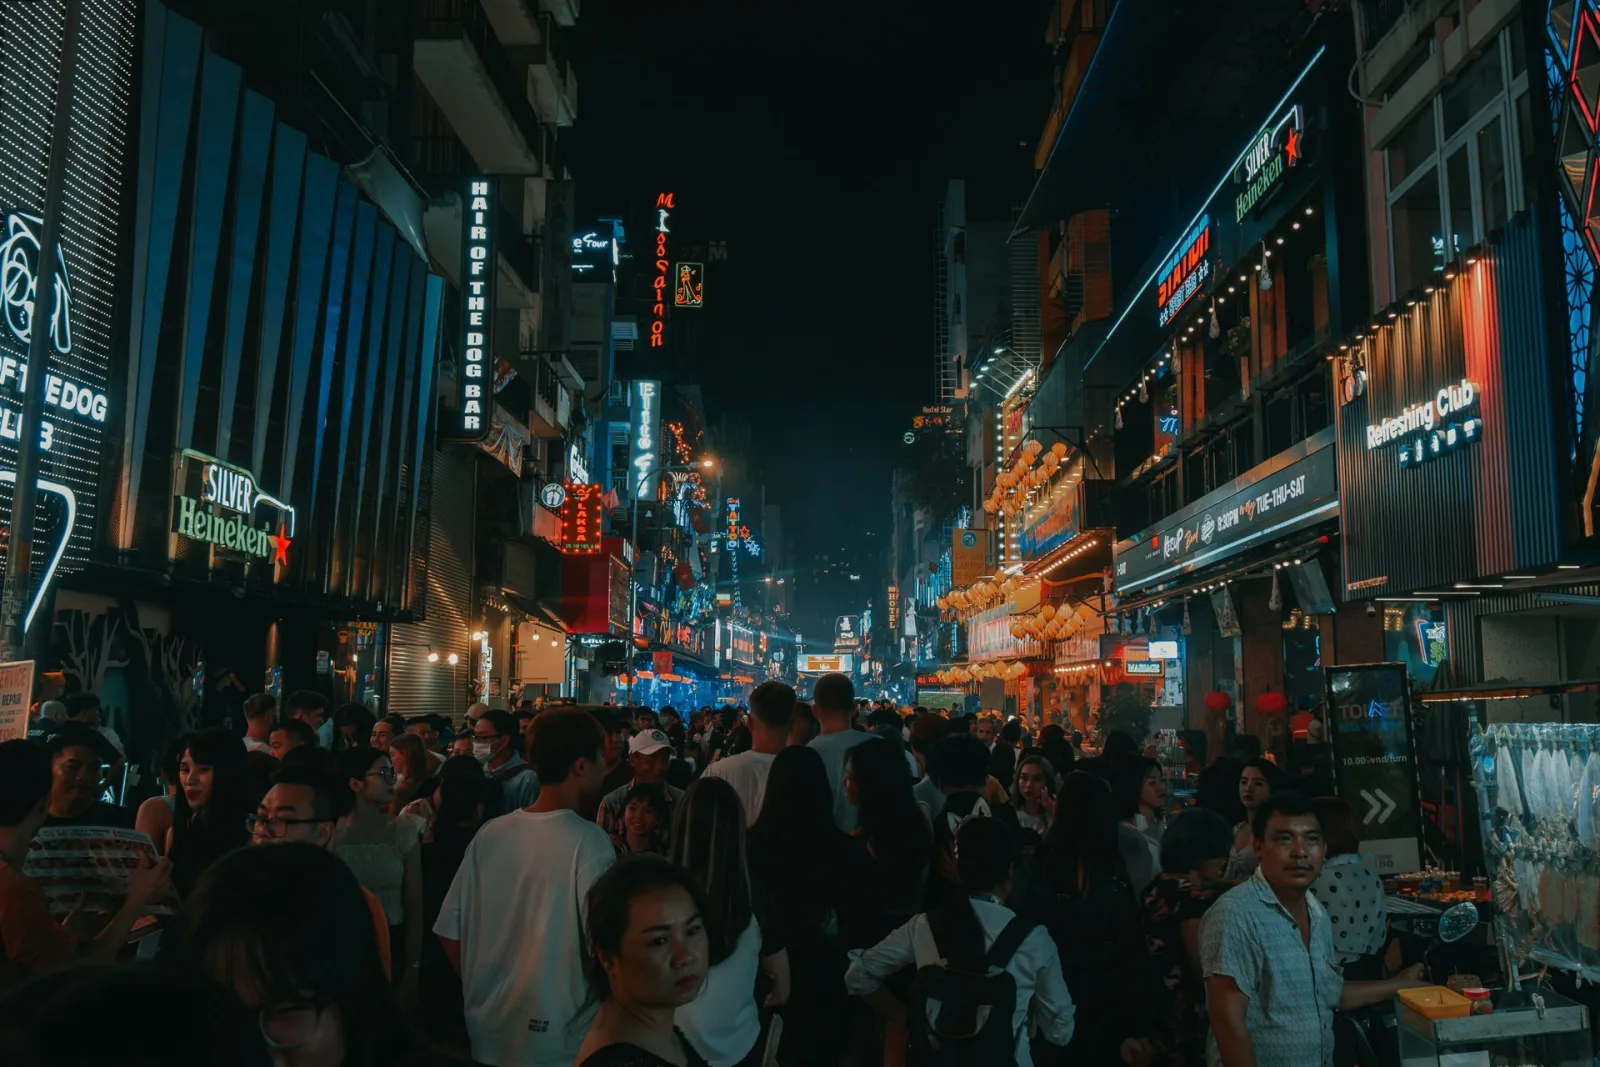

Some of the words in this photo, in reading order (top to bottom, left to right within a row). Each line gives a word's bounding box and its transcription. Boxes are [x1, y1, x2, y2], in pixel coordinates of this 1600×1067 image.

[1245, 132, 1270, 182] SILVER
[471, 182, 488, 239] HAIR
[1236, 153, 1283, 223] Heineken
[470, 246, 486, 275] OF
[468, 282, 485, 325] THE
[466, 333, 483, 377] DOG
[464, 384, 481, 429] BAR
[1366, 400, 1434, 450] Refreshing
[1436, 378, 1474, 417] Club
[207, 464, 252, 514] SILVER
[1256, 474, 1305, 515] TUE-THU-SAT
[178, 495, 268, 557] Heineken
[576, 503, 587, 541] LAKSA
[728, 504, 738, 548] TATTOO
